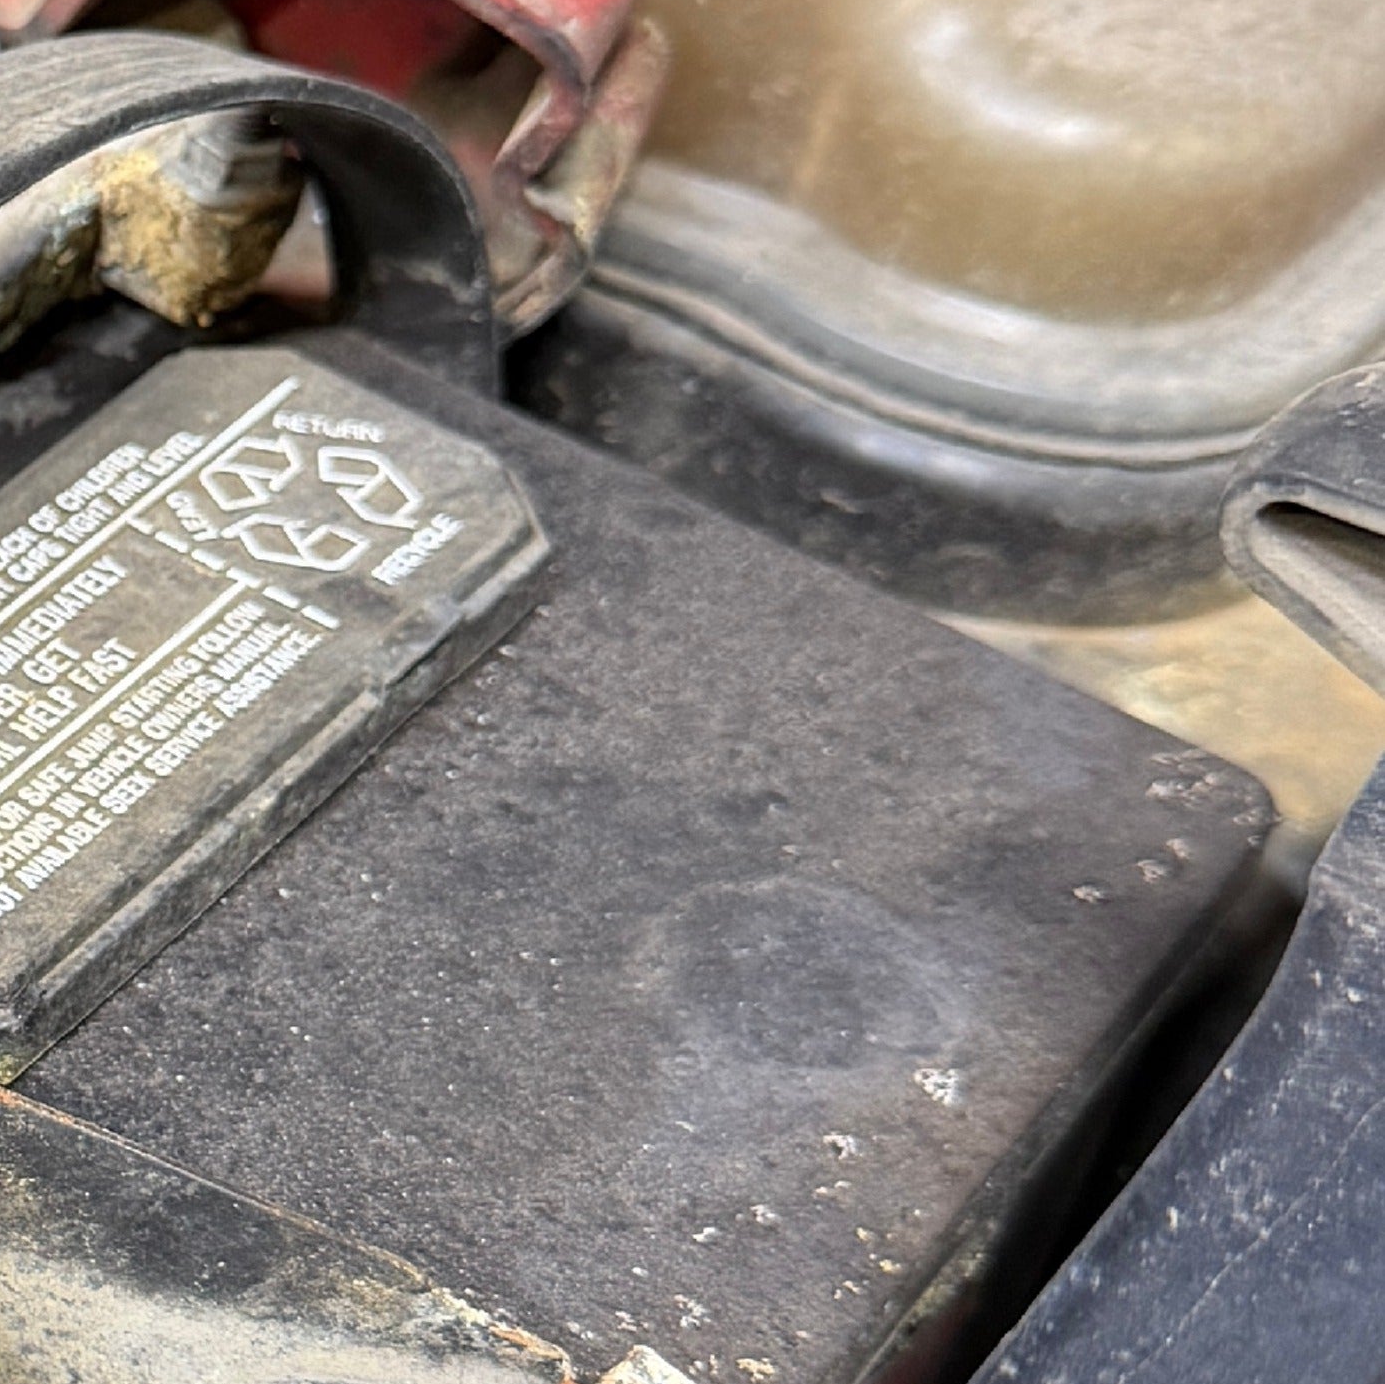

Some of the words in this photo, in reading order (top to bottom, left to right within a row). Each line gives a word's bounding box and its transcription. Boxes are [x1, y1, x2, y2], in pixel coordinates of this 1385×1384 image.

[272, 412, 387, 444] RETURN
[7, 540, 67, 584] CAPS
[53, 498, 115, 544] TIGHT
[108, 471, 153, 505] AND
[28, 504, 61, 533] OF
[166, 490, 221, 540] LEAD
[371, 512, 466, 586] RECYCLE
[9, 685, 78, 741] HELP
[67, 637, 138, 693] FAST
[18, 761, 77, 808] SAFE
[64, 723, 120, 771] JUMP
[109, 655, 202, 730] STARTING
[188, 600, 267, 663] FOLLOW
[21, 637, 82, 685] GET
[49, 791, 87, 821] IN
[76, 734, 154, 800] VEHICLE
[140, 673, 226, 741] OWNERS
[14, 806, 112, 891] AVAILABLE
[99, 768, 156, 815] SEEK
[143, 710, 225, 778] SERVICE
